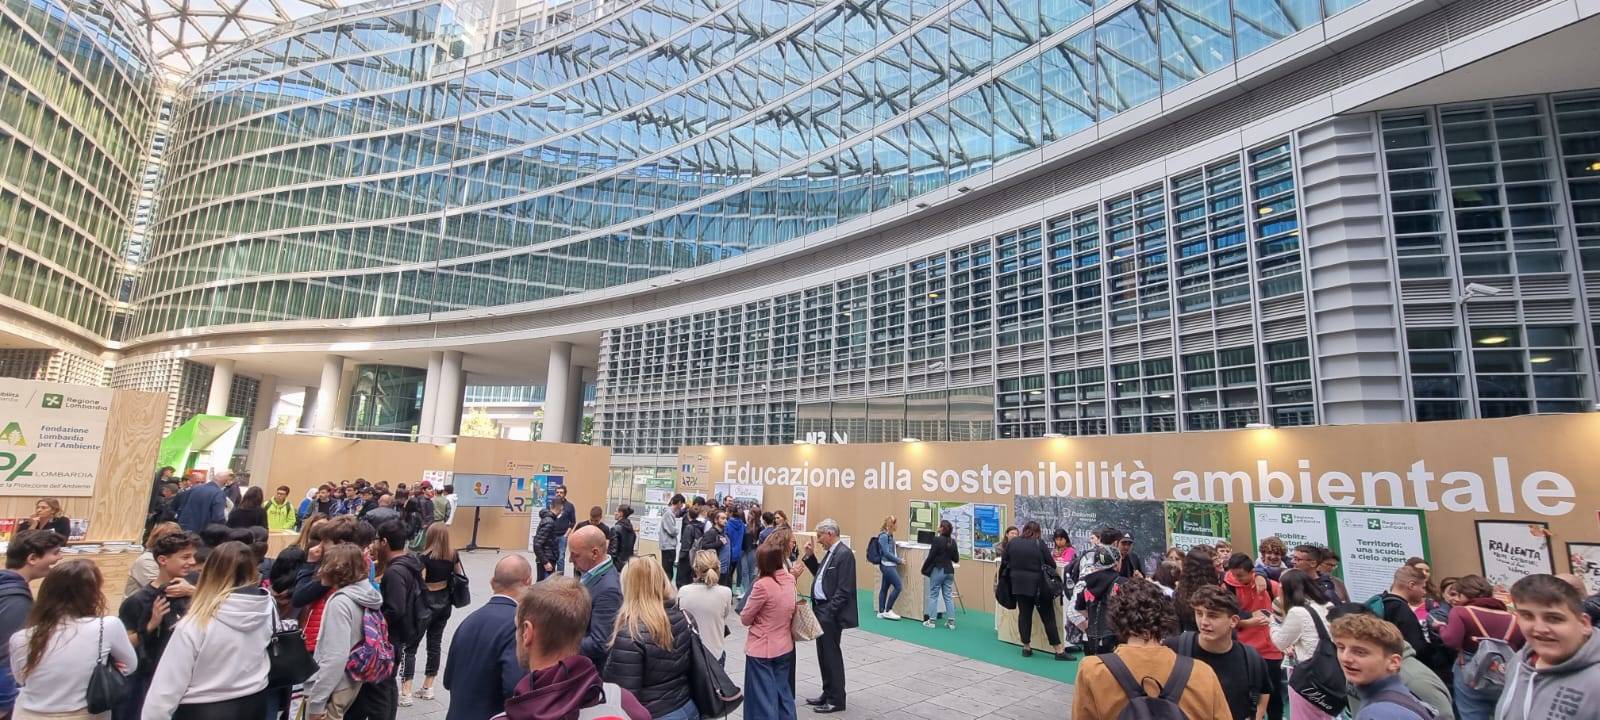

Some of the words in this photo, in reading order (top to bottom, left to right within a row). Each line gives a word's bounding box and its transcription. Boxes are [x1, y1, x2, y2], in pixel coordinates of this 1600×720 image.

[66, 397, 100, 405] Regione
[65, 403, 108, 411] Lombardia
[40, 425, 89, 434] Fondazione
[39, 433, 84, 441] Lombardia
[724, 460, 856, 489] Educazione
[863, 461, 912, 491] alla
[921, 460, 1155, 500] sostenibilità
[1172, 457, 1577, 516] ambientale
[1356, 538, 1402, 548] Territorio:
[1375, 548, 1405, 556] scuola
[1381, 556, 1408, 564] apert
